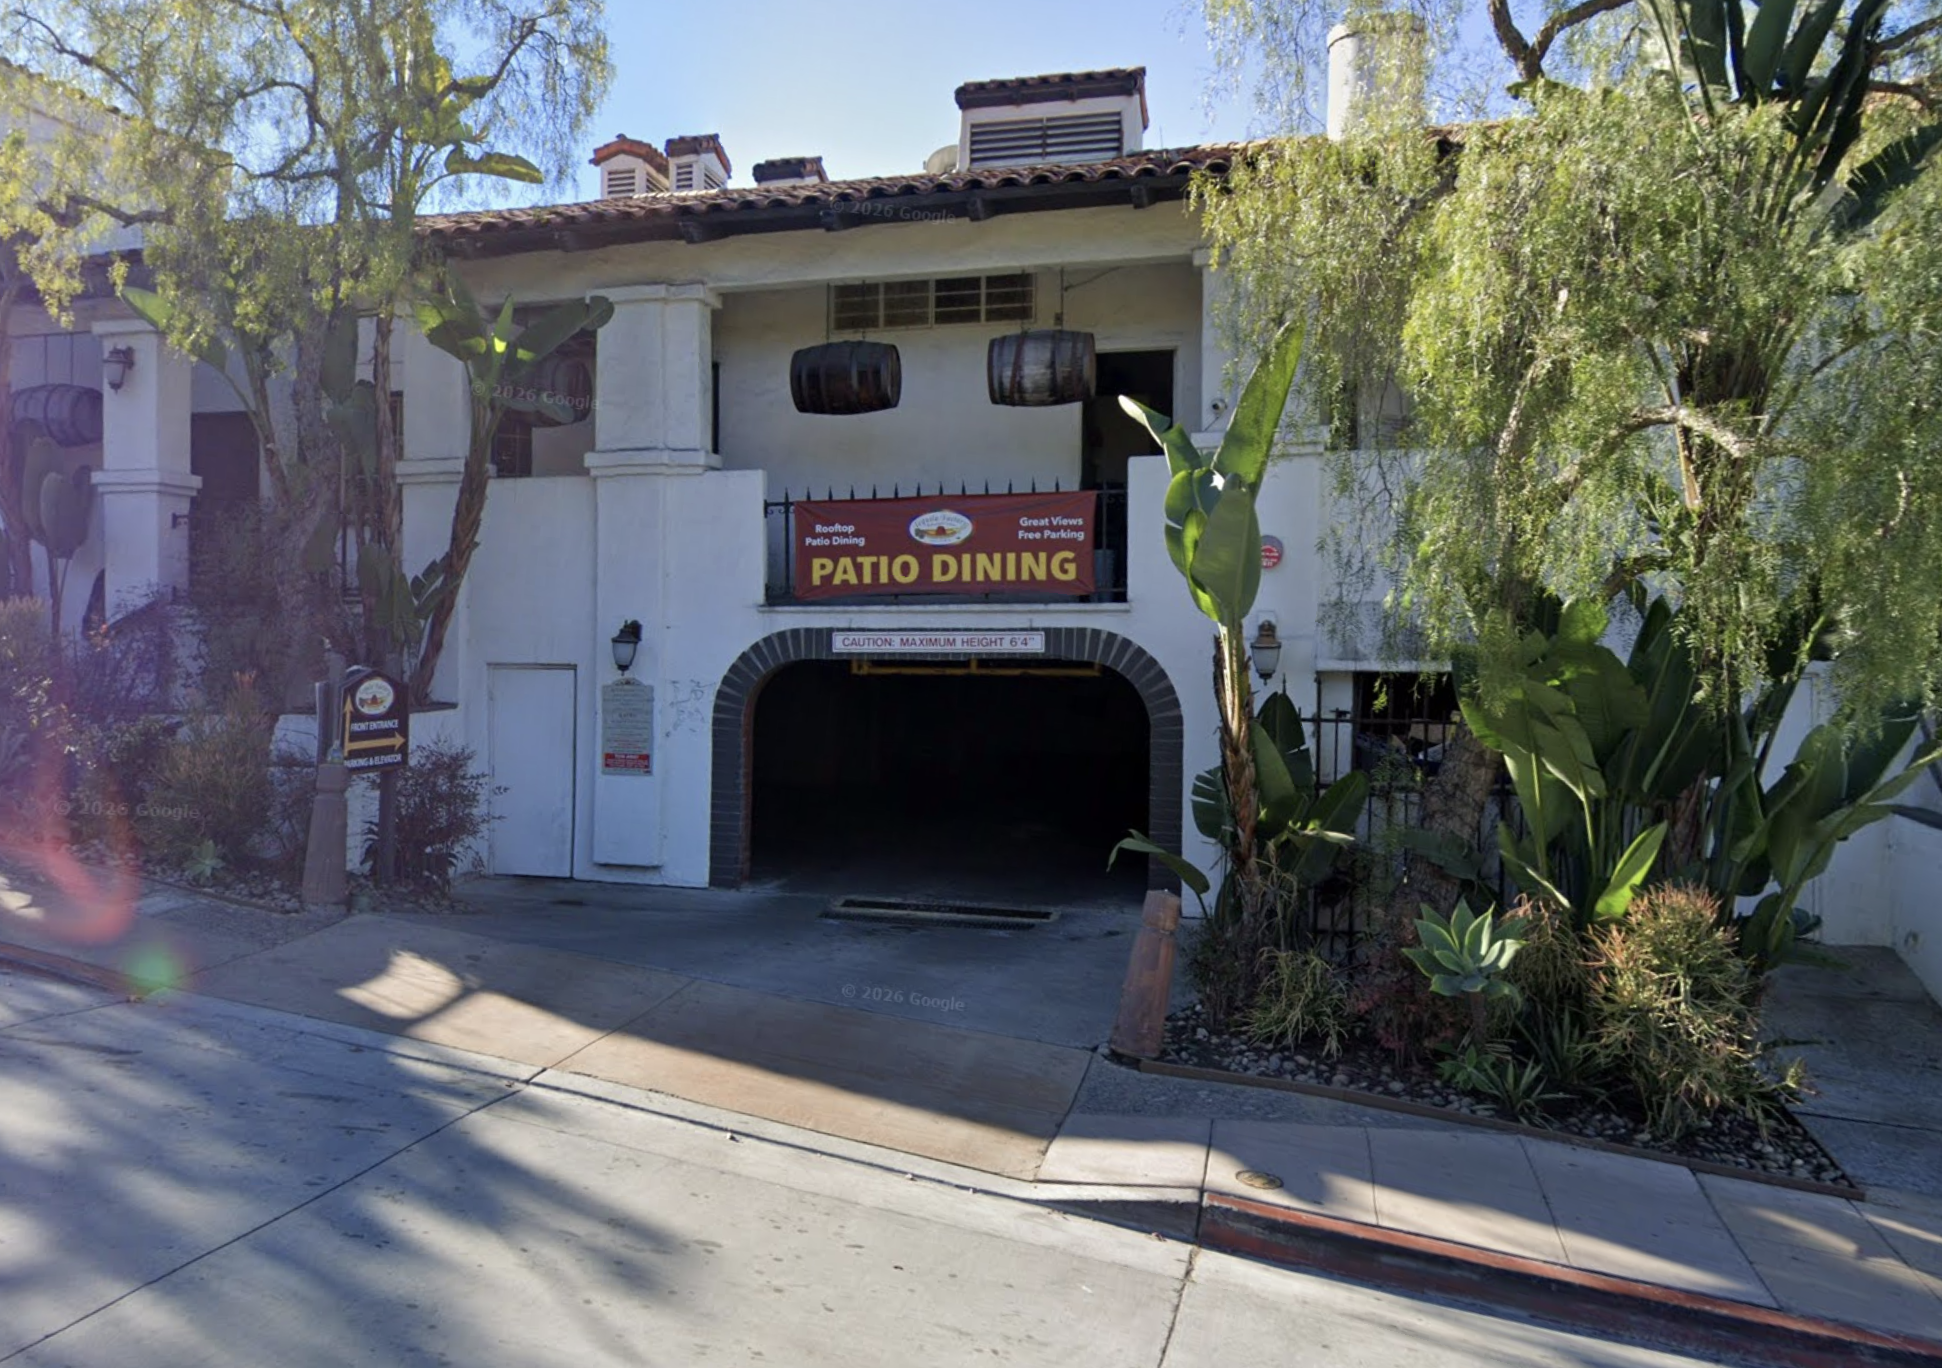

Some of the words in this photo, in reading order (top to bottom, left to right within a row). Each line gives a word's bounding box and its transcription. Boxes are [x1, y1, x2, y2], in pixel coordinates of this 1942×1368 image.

[1019, 516, 1049, 527] Great
[1050, 516, 1084, 527] Views
[815, 523, 855, 535] Rooftop
[1018, 530, 1042, 540] Free
[1044, 529, 1085, 541] Parking
[805, 536, 830, 547] Patio
[832, 535, 866, 547] Dining
[811, 554, 920, 586] PATIO
[932, 550, 1077, 582] DINING
[842, 636, 895, 648] CAUTION:
[900, 636, 956, 648] MAXIMUM
[961, 636, 1005, 648] HEIGHT
[1009, 636, 1035, 648] 6'4"
[351, 722, 368, 731] FRONT
[369, 720, 399, 730] ENTRANCE
[375, 754, 402, 765] ELEVATOR
